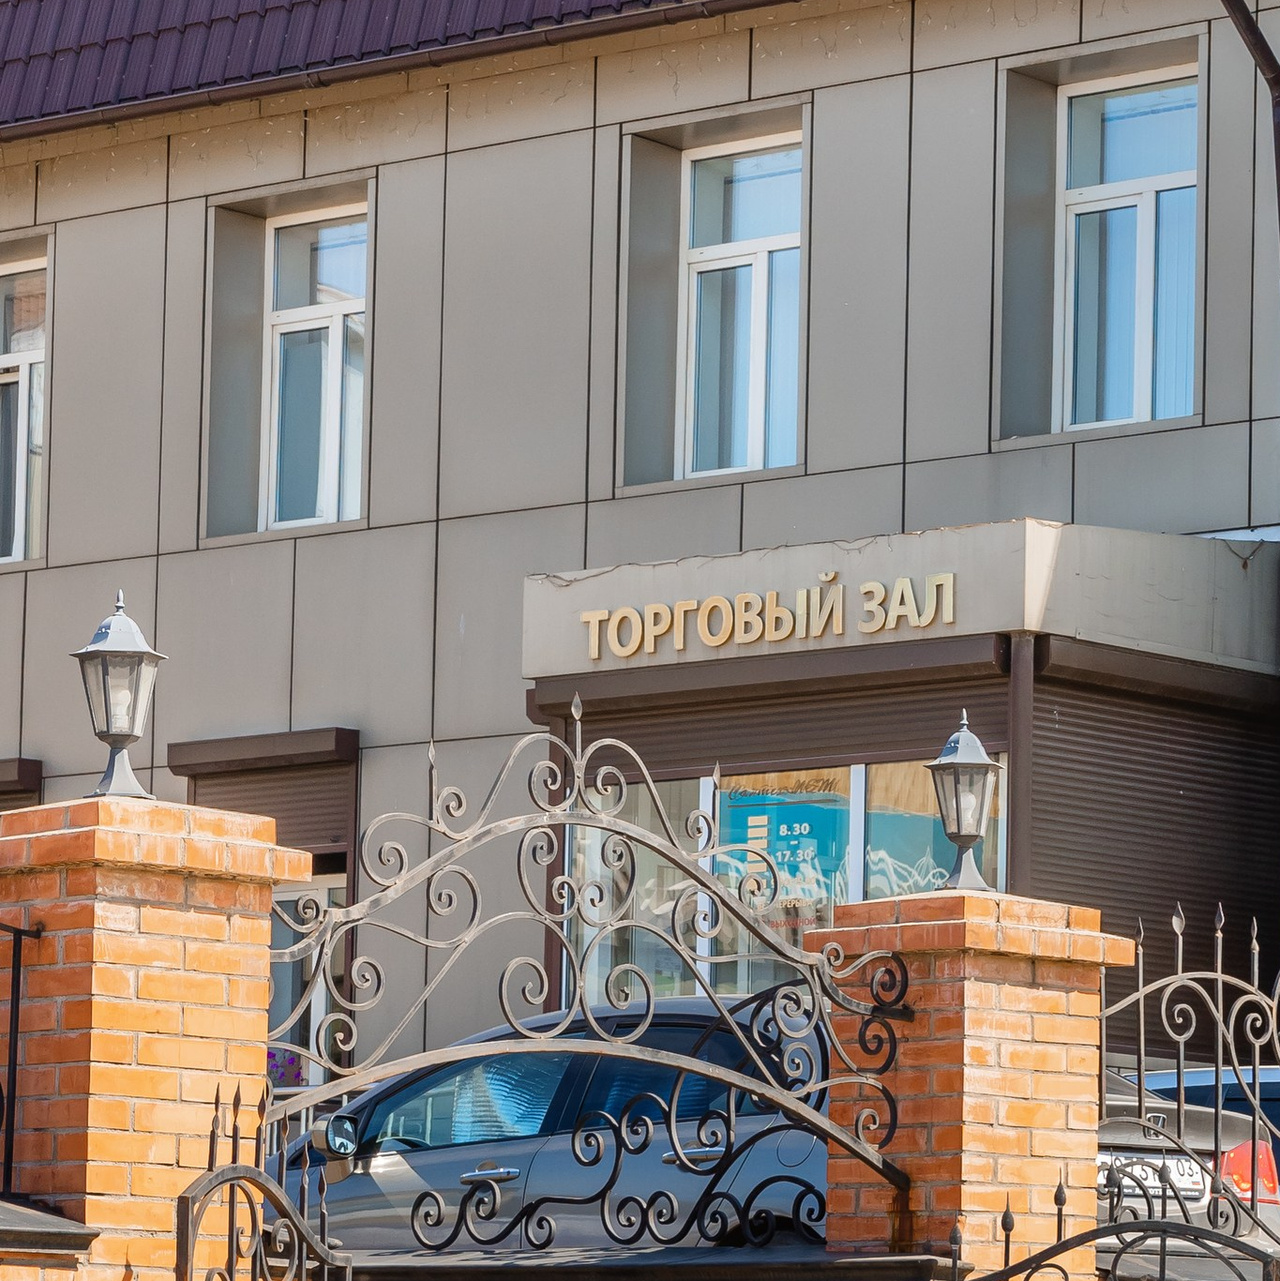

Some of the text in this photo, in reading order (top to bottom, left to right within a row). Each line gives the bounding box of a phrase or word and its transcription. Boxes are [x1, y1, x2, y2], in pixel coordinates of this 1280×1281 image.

[580, 571, 957, 660] ТОРГОВЫЙ ЗАЛ
[779, 822, 810, 836] 8.30
